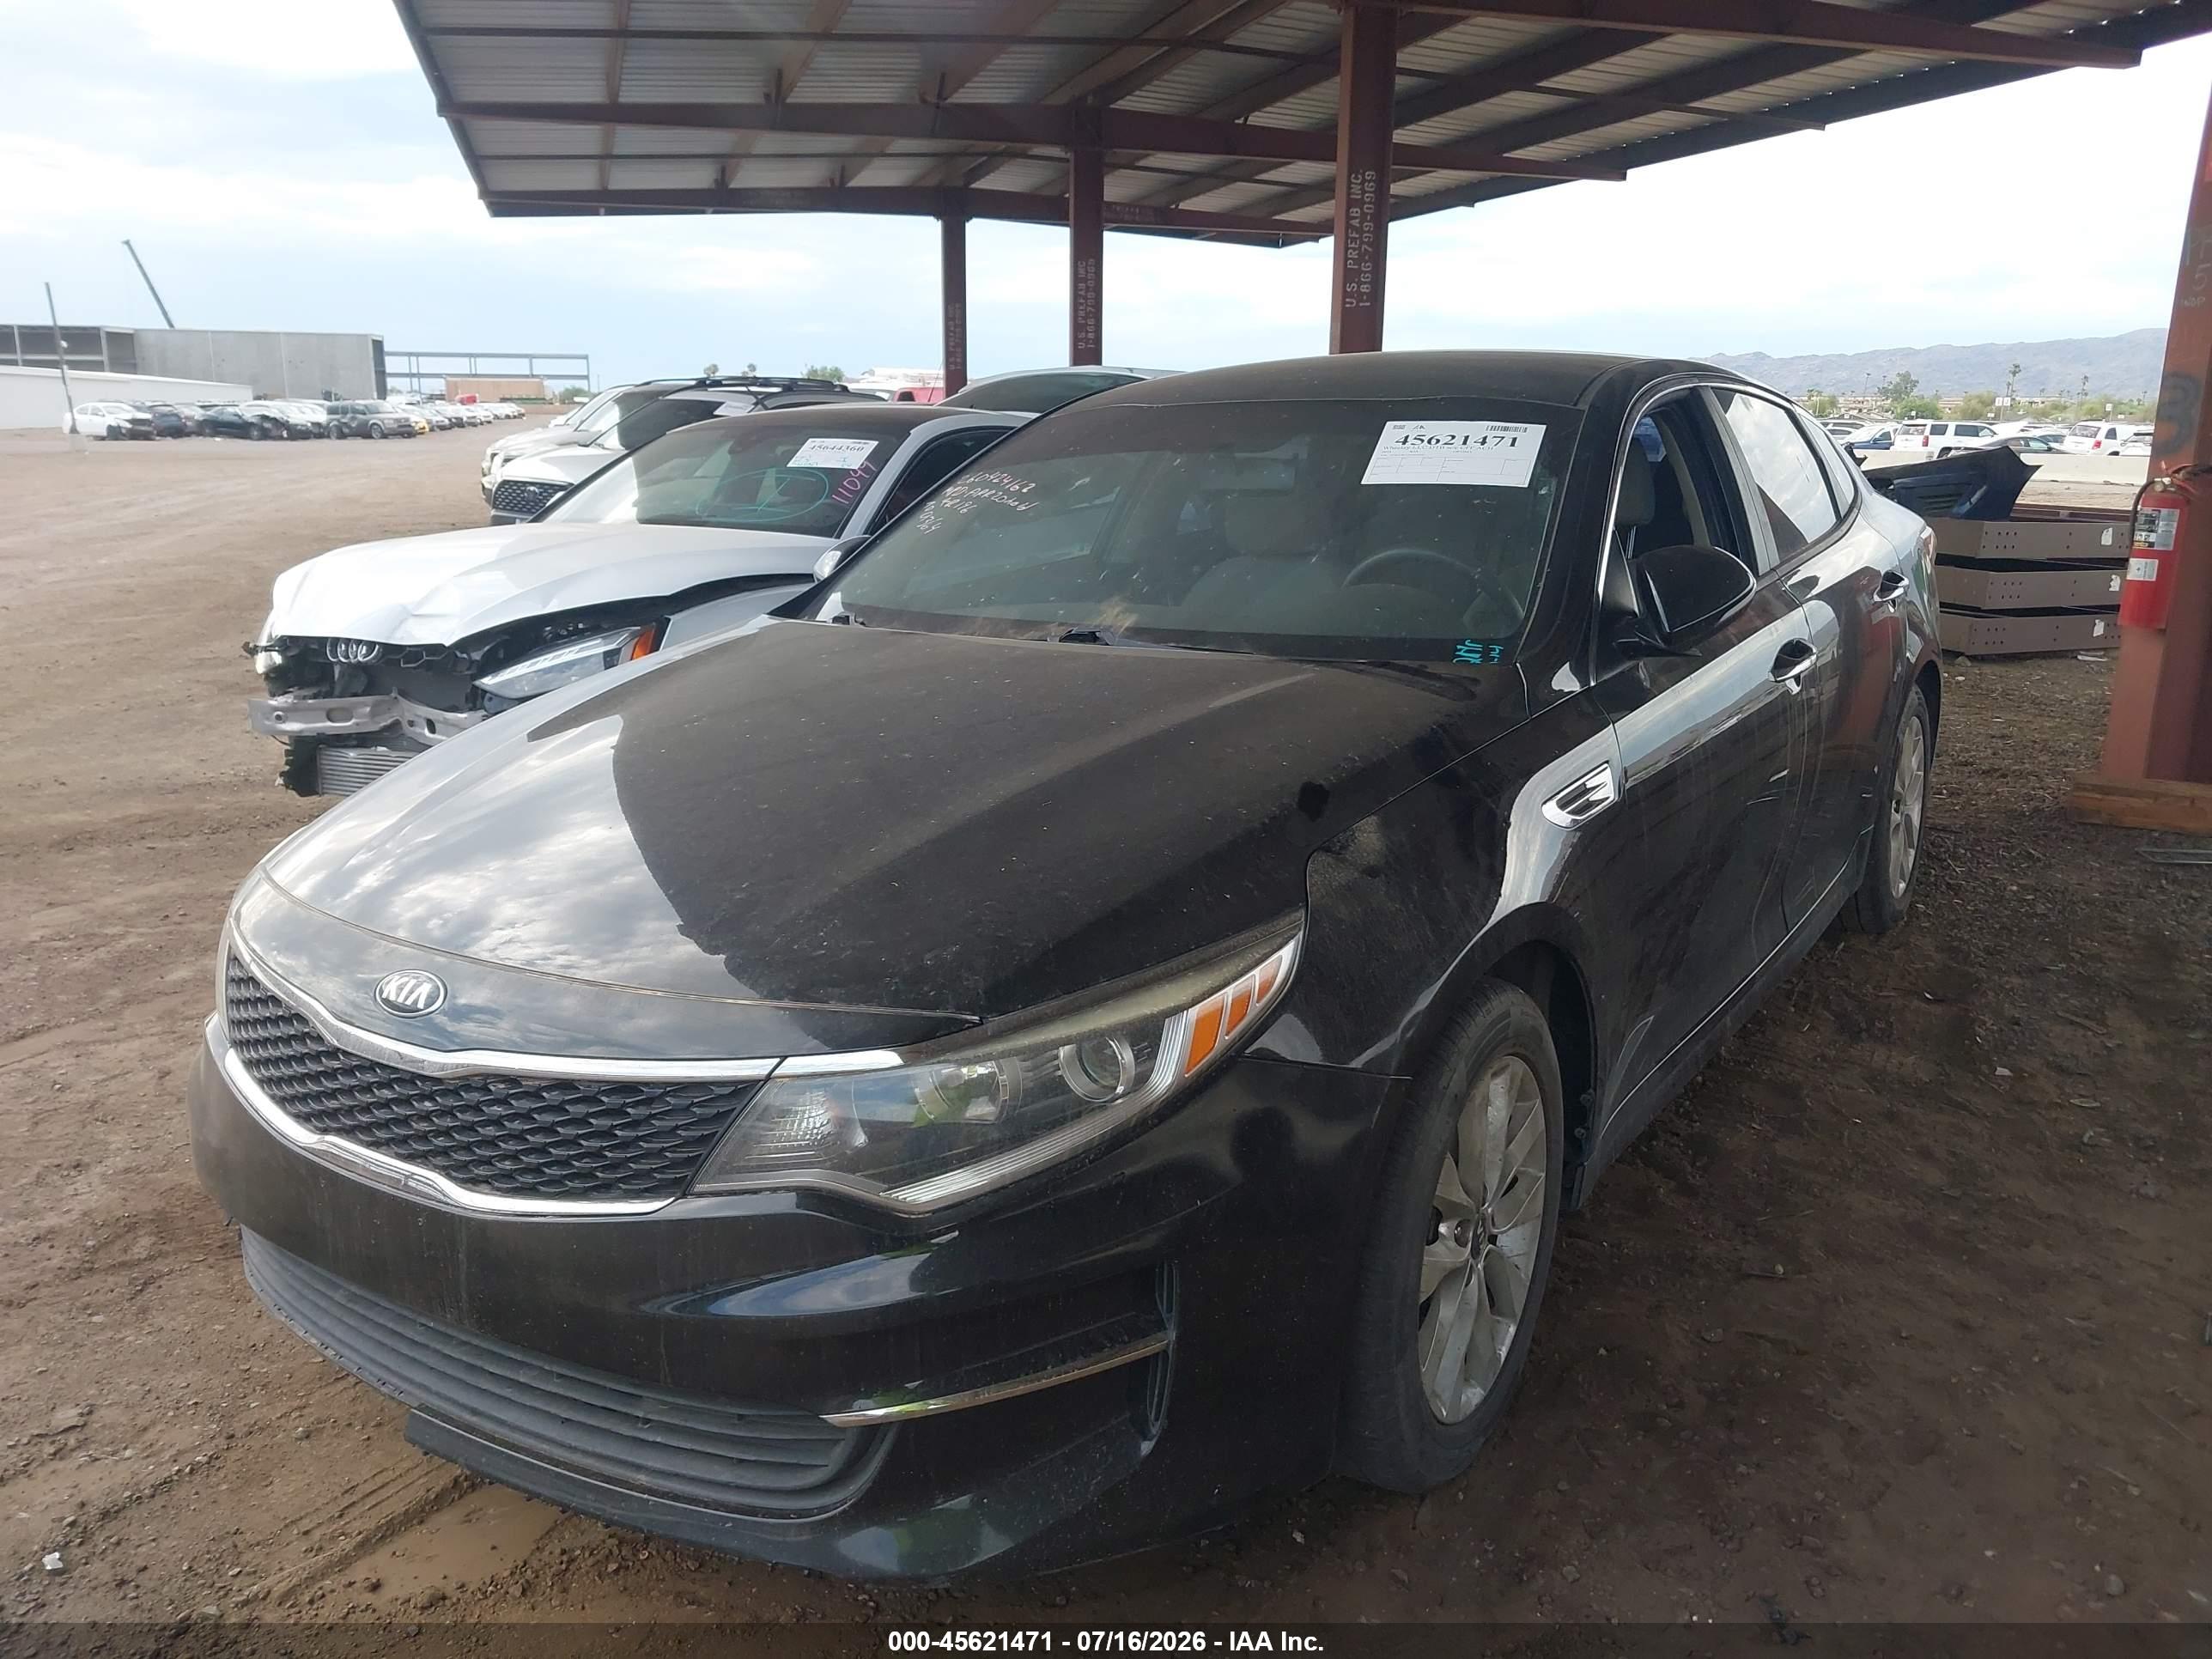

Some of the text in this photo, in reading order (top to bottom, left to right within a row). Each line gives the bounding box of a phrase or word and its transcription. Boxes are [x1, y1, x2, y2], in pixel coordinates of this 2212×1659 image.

[1345, 169, 1363, 307] U.S. PREFAB INC.
[1359, 171, 1376, 307] 1-866-799-0969
[1395, 434, 1518, 448] 45621471
[381, 975, 433, 1010] KIA
